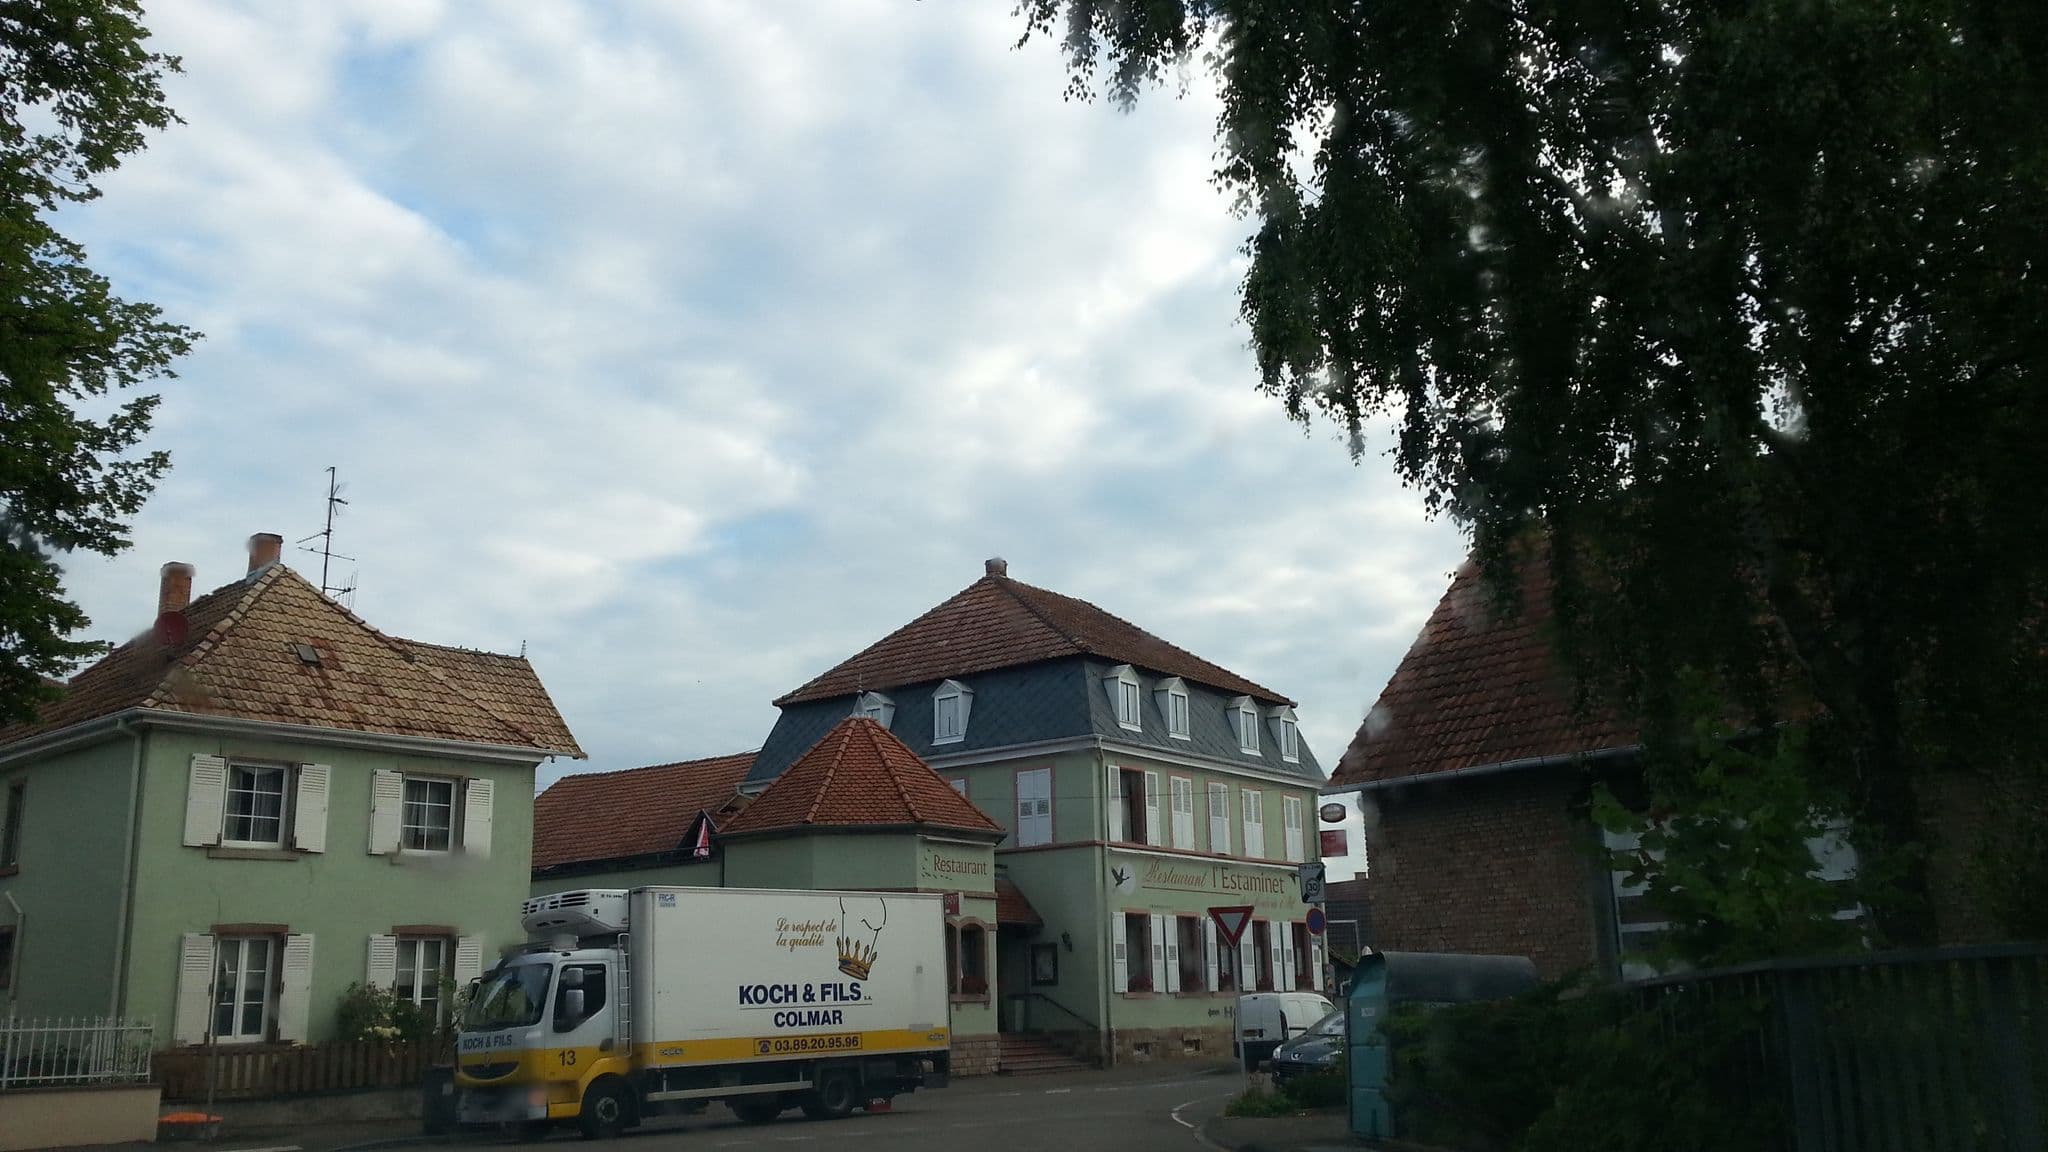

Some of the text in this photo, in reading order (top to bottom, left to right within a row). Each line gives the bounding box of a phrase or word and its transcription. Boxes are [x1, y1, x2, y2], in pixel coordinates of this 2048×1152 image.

[934, 854, 988, 876] Restaurant
[1142, 857, 1285, 894] Restaurant l'Estaminet
[776, 917, 837, 937] Le respect de
[776, 932, 825, 952] la qualité
[739, 984, 798, 1005] KOCH
[802, 983, 816, 1003] &
[820, 982, 862, 1002] FILS
[773, 1010, 843, 1028] COLMAR
[463, 1034, 513, 1050] KOCH & FILS
[774, 1036, 860, 1052] 03.89.20.95.96
[559, 1049, 577, 1067] 13
